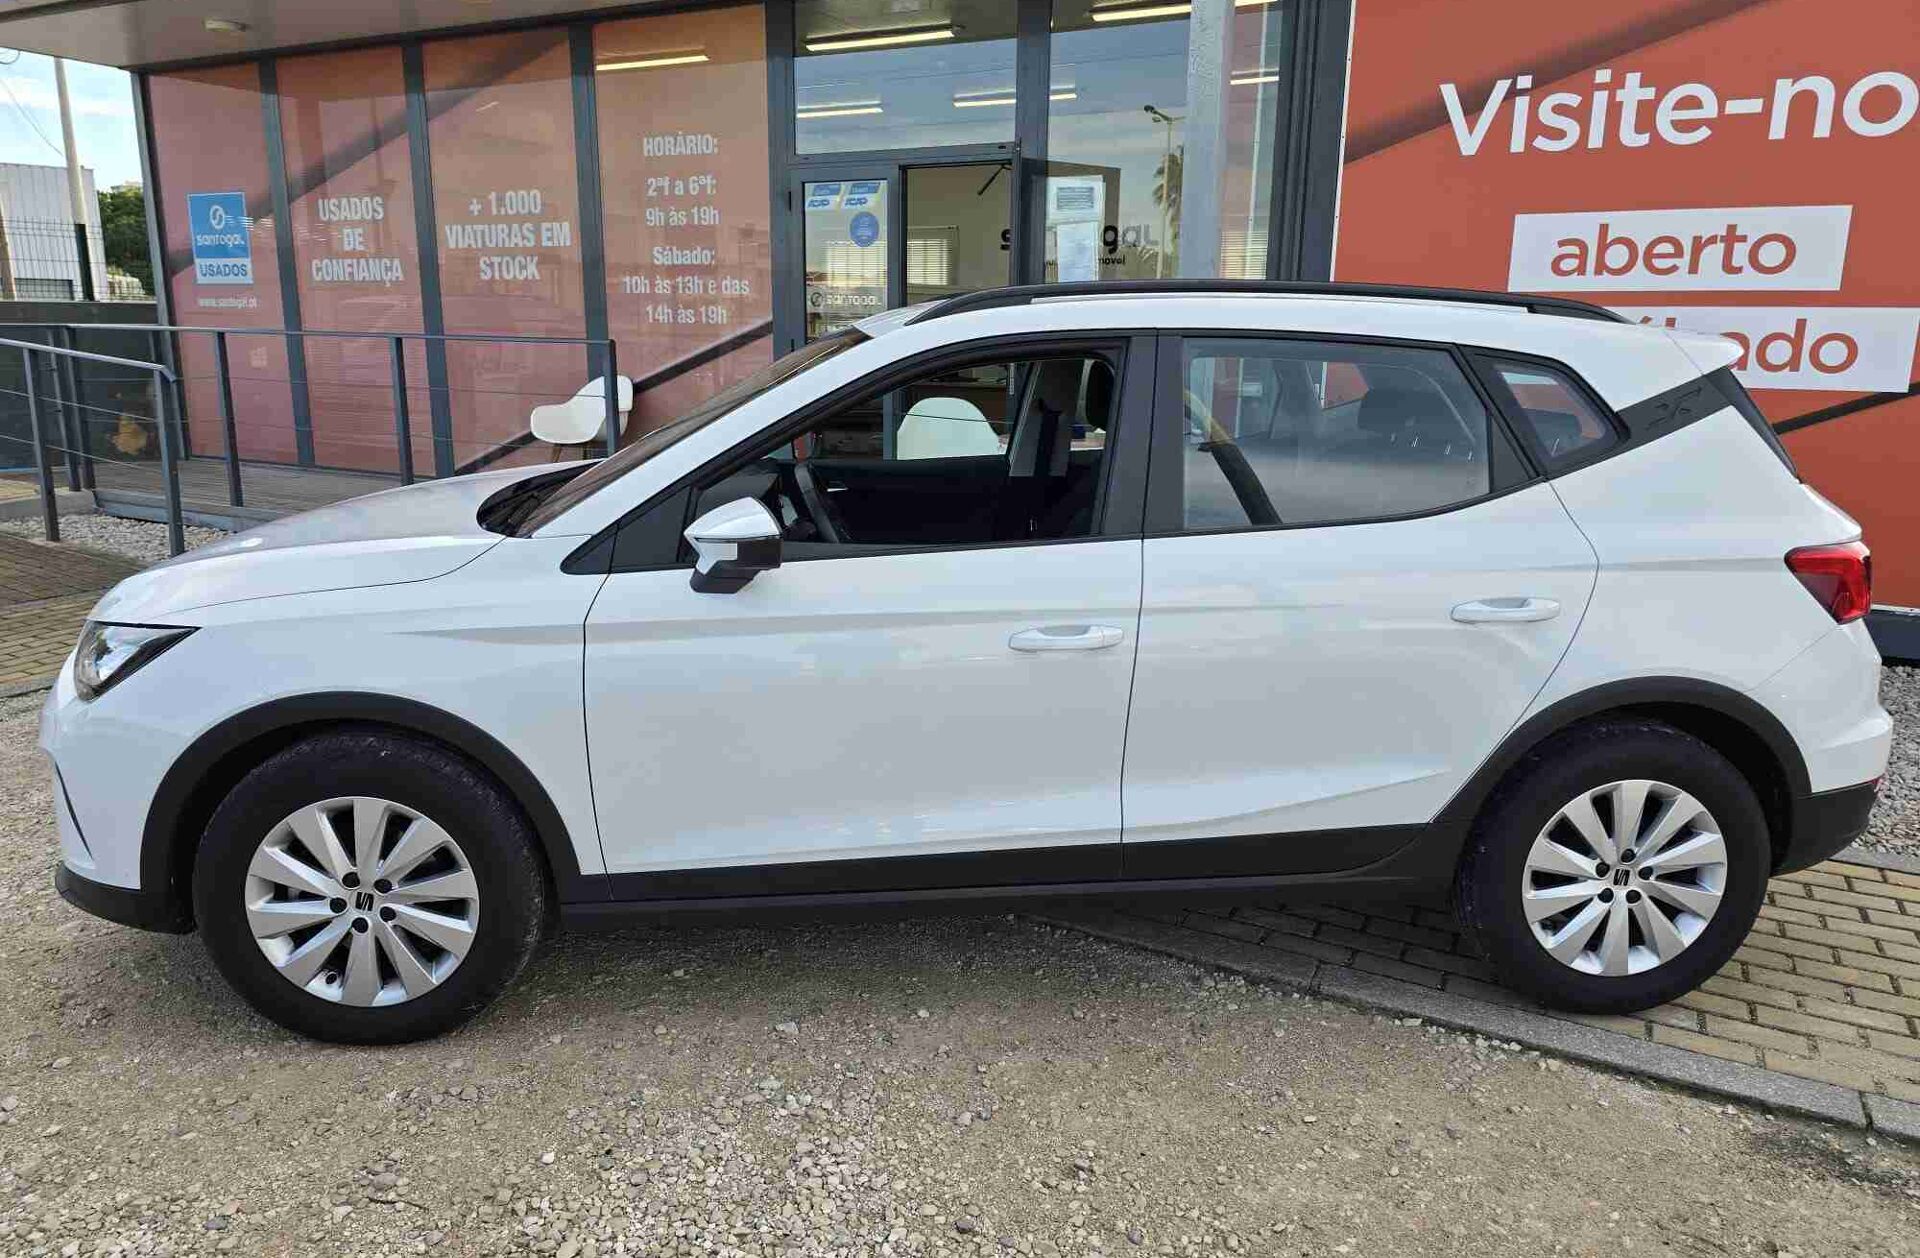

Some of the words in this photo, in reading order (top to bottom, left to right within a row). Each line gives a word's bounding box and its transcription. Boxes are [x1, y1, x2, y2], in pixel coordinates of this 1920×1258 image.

[643, 131, 719, 157] HORÁRIO:
[674, 179, 684, 196] a
[317, 196, 385, 222] USADOS
[469, 199, 482, 216] +
[489, 189, 542, 216] 1.000
[646, 207, 665, 226] 9h
[669, 206, 687, 226] às
[690, 206, 719, 225] 19h
[342, 228, 364, 251] DE
[444, 223, 535, 249] VIATURAS
[541, 221, 572, 247] EM
[653, 246, 716, 267] Sábado:
[1550, 223, 1797, 277] aberto
[199, 263, 248, 278] USADOS
[311, 257, 405, 287] CONFIANÇA
[479, 254, 541, 281] STOCK
[623, 275, 650, 295] 10h
[654, 274, 671, 295] às
[675, 275, 703, 295] 13h
[708, 279, 718, 295] e
[721, 275, 750, 295] das
[645, 304, 672, 324] 14h
[676, 304, 697, 323] às
[700, 304, 728, 325] 19h
